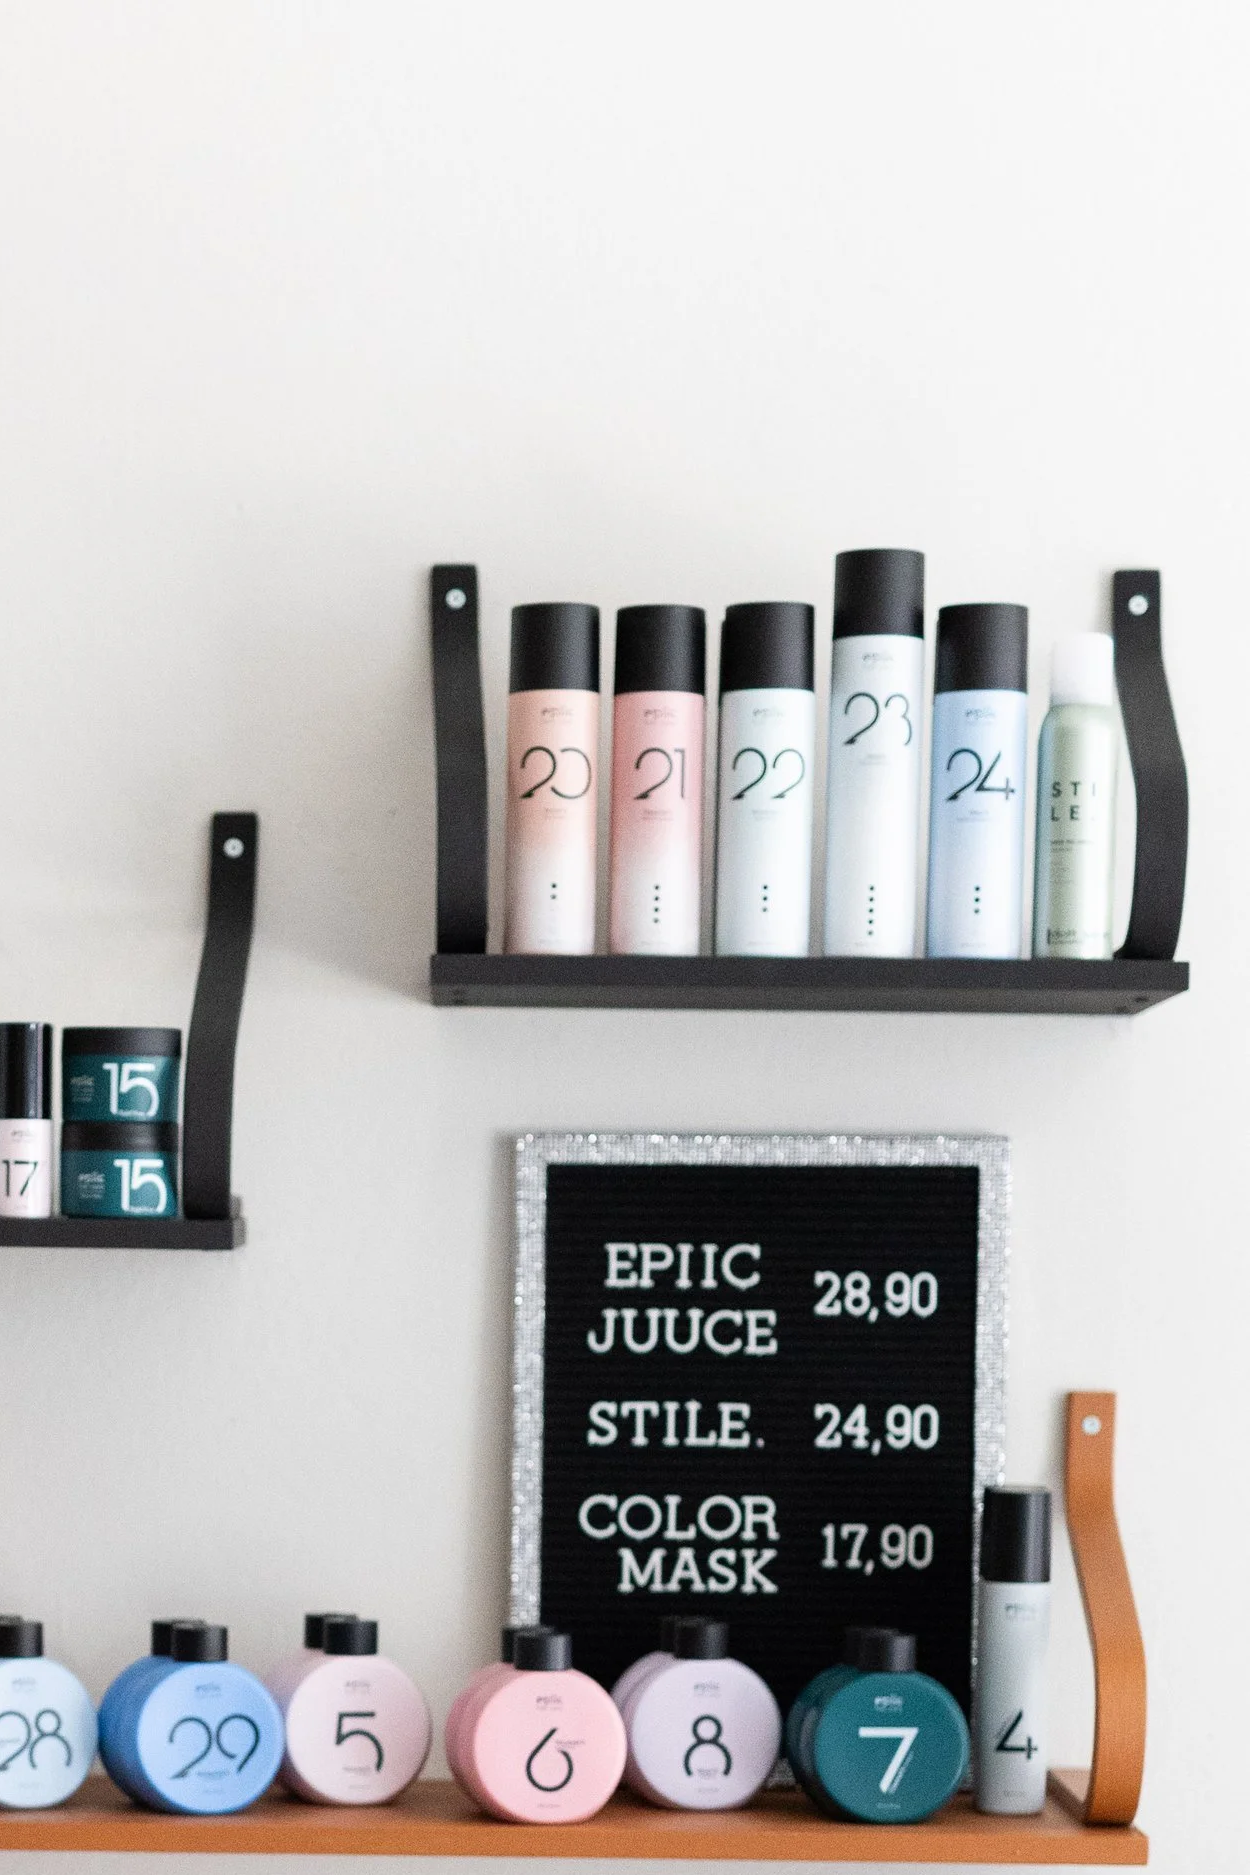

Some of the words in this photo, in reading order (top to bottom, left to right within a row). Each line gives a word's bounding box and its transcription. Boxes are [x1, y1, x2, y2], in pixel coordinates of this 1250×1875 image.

[843, 691, 913, 746] 23
[519, 745, 592, 801] 20
[634, 747, 686, 801] 21
[731, 747, 806, 801] 22
[945, 747, 1016, 802] 24
[102, 1062, 160, 1118] 15
[1, 1159, 39, 1198] 17
[112, 1158, 168, 1214] 15
[605, 1242, 762, 1291] EPIIC
[814, 1271, 939, 1323] 28,90
[587, 1307, 779, 1357] JUUCE
[587, 1400, 766, 1449] STILE.
[814, 1404, 941, 1456] 24,90
[578, 1495, 780, 1542] COLOR
[617, 1547, 779, 1595] MASK
[821, 1523, 934, 1576] 17,90
[168, 1713, 261, 1780] 29
[334, 1711, 385, 1773] 5
[525, 1726, 575, 1793] 6
[683, 1713, 733, 1777] 8
[857, 1726, 919, 1794] 7
[995, 1709, 1039, 1761] 4
